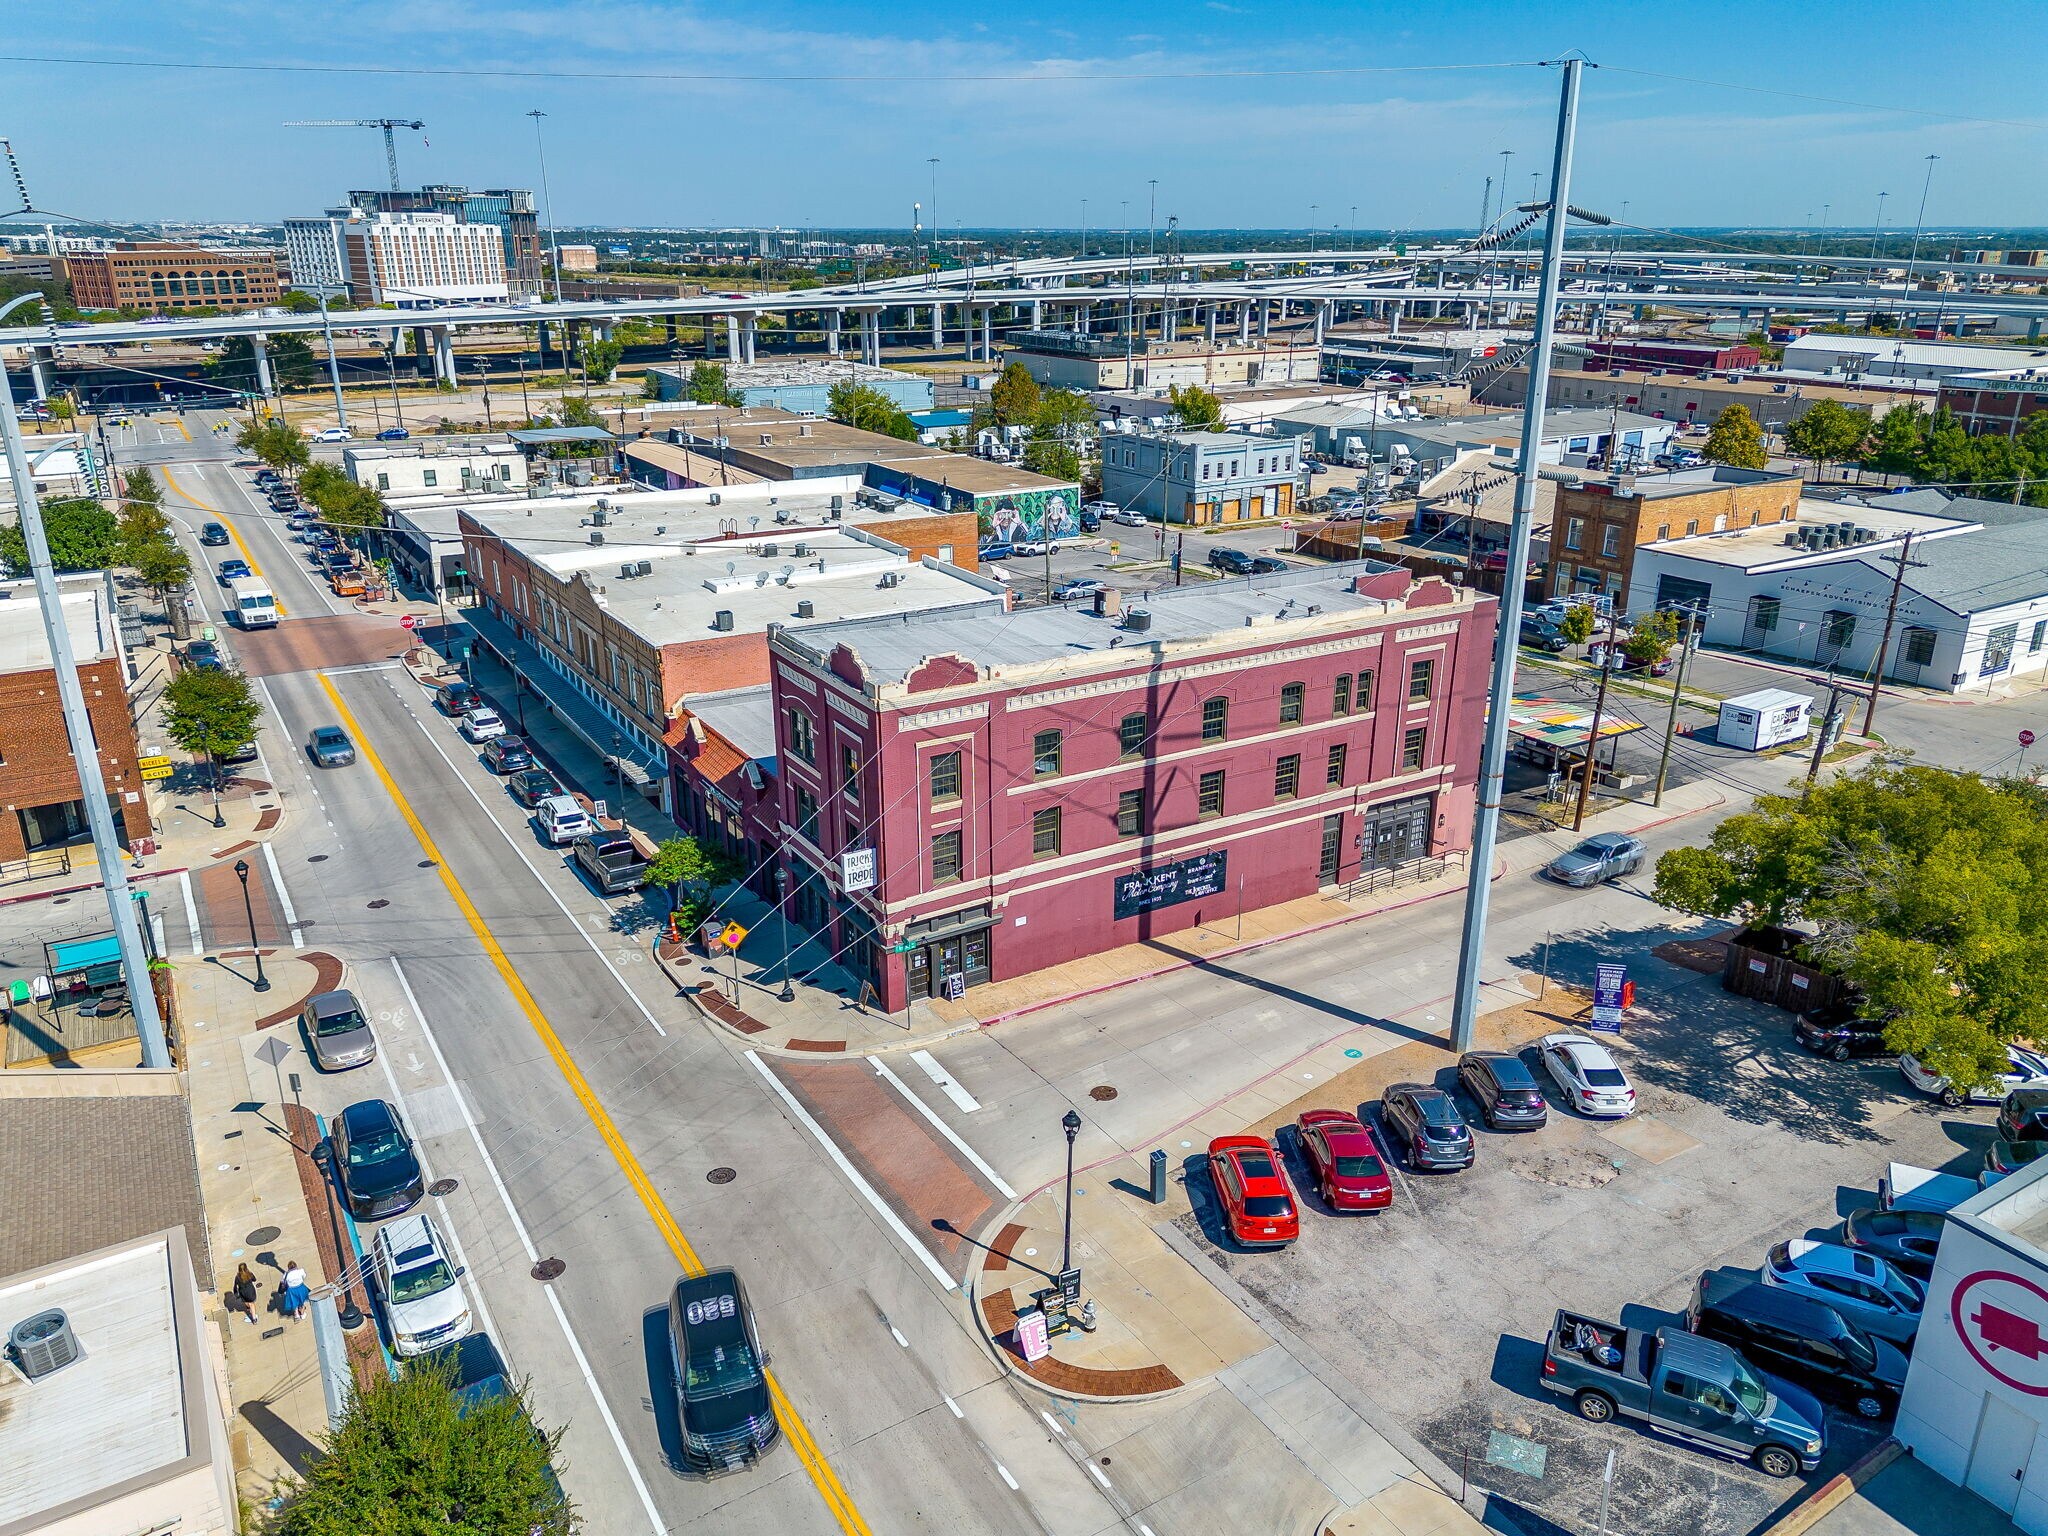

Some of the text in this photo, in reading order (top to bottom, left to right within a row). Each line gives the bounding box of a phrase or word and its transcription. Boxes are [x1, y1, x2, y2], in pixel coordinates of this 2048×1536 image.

[1986, 381, 2027, 391] SUPREME
[96, 469, 111, 497] STAGE
[1780, 584, 1821, 597] SCHAEFER
[1823, 593, 1878, 608] ADVERTISING
[1727, 711, 1752, 724] CAPSULE
[1773, 707, 1800, 724] CAPSULE
[2020, 733, 2034, 742] STOP
[152, 769, 169, 778] CITY
[847, 853, 873, 868] TRICKS
[848, 868, 873, 885] TRADE
[1153, 870, 1177, 885] KENT
